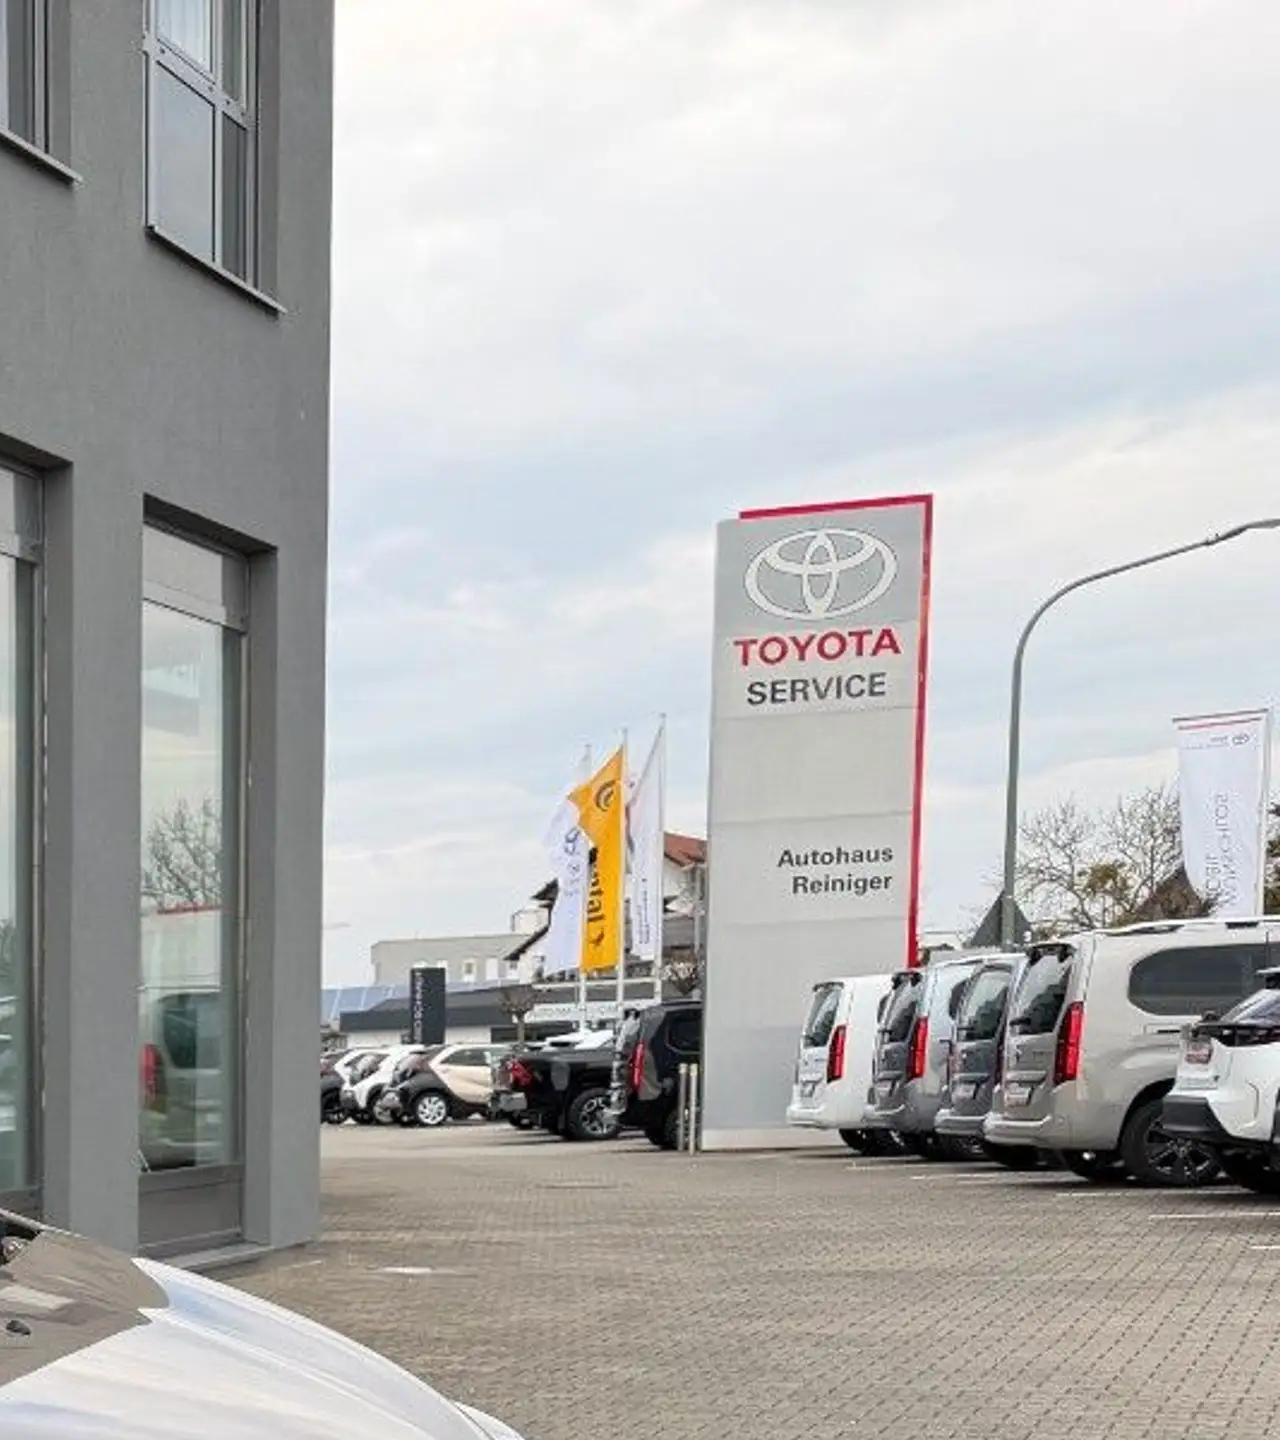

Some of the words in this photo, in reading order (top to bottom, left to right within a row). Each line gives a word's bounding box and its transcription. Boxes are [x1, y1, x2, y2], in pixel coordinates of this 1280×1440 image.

[733, 628, 901, 666] TOYOTA
[747, 672, 887, 706] SERVICE
[777, 846, 893, 868] Autohaus
[792, 873, 893, 896] Reiniger
